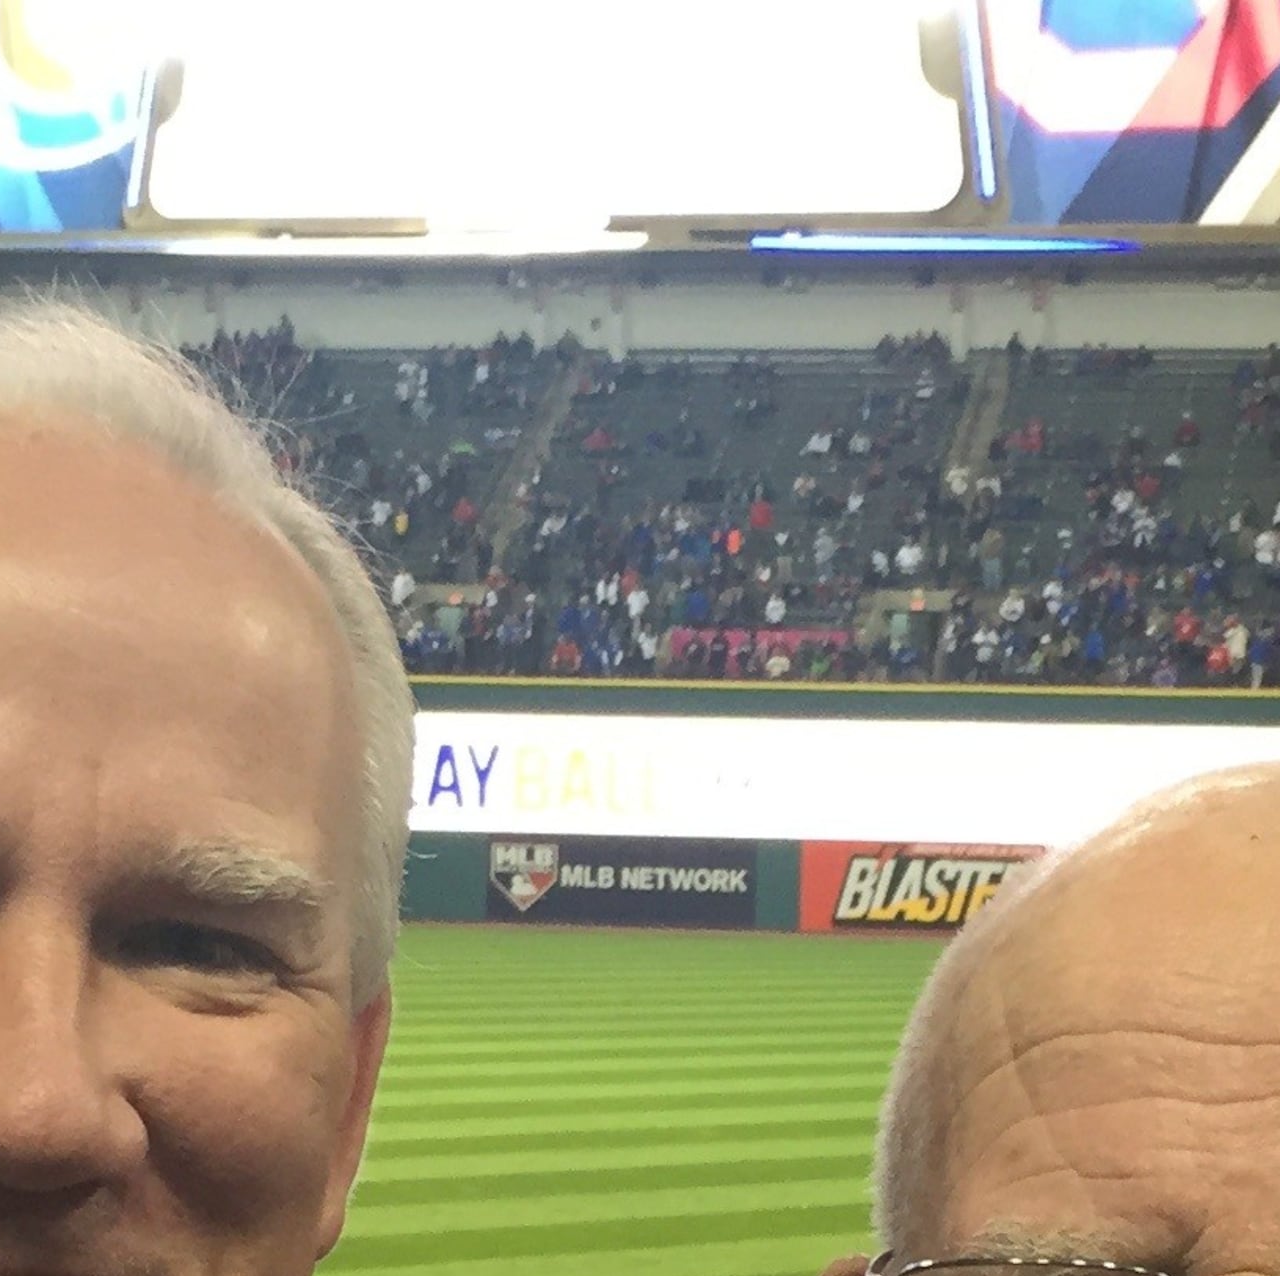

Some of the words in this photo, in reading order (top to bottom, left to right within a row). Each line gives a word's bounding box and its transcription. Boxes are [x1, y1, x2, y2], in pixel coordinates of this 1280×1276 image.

[560, 864, 615, 890] MLB
[620, 866, 748, 894] NETWORK
[834, 857, 1006, 923] BLASTE
